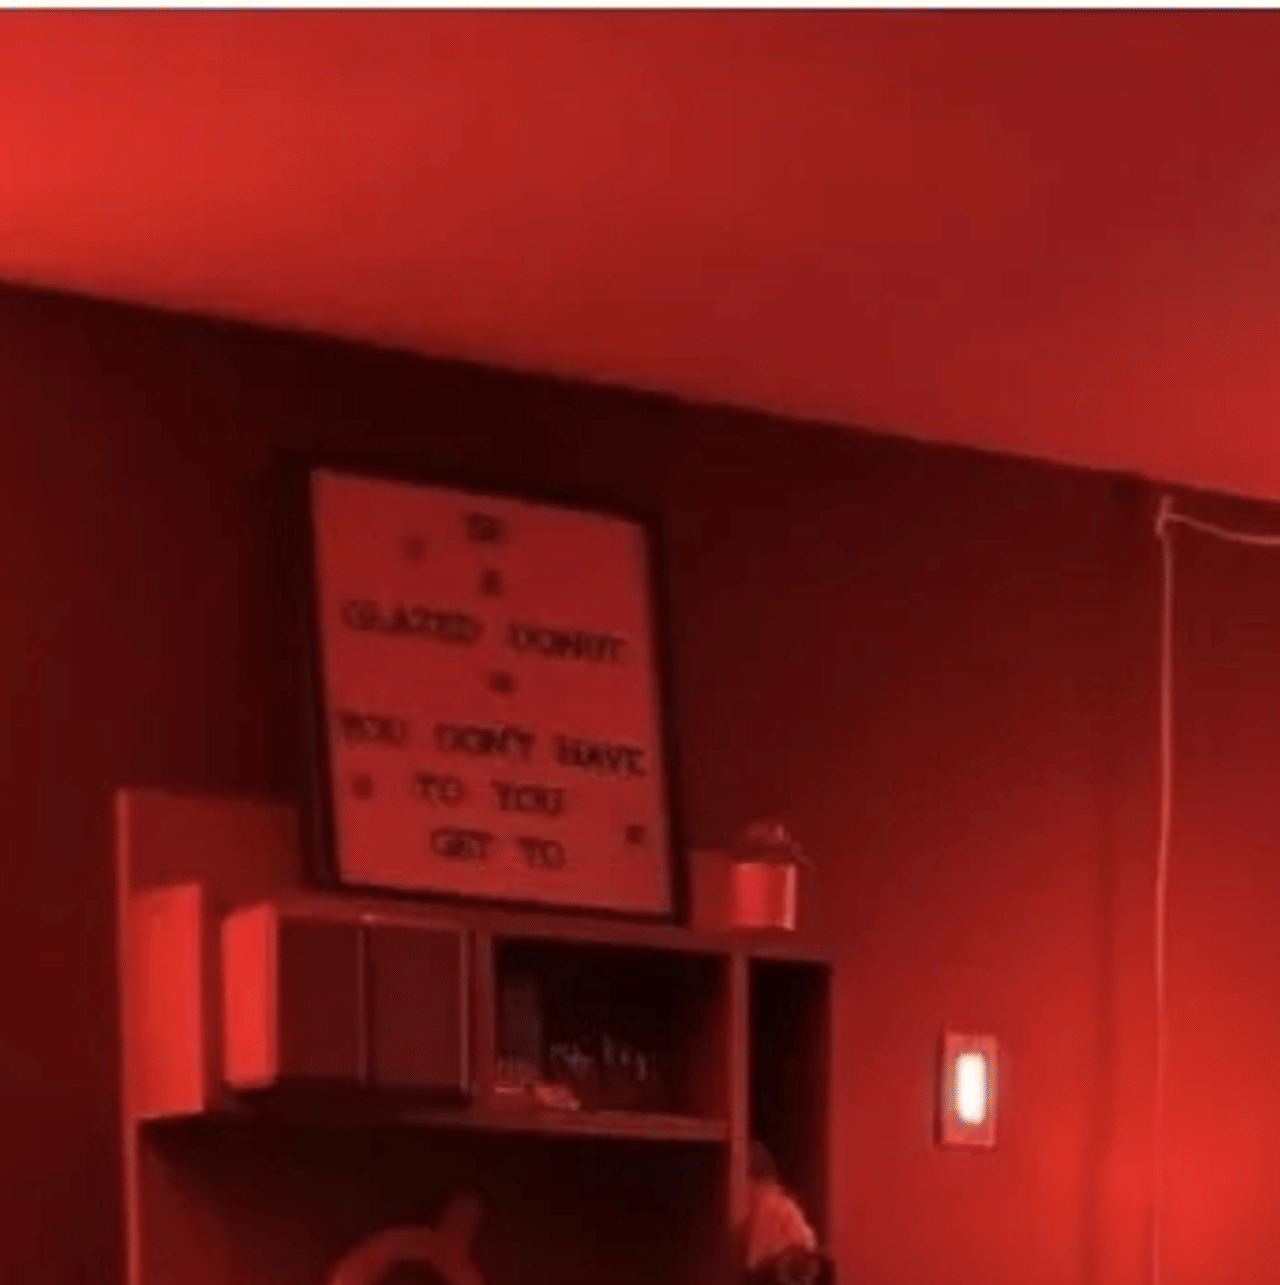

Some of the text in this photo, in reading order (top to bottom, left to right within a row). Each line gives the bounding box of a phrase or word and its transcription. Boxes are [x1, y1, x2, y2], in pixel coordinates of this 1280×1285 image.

[340, 599, 627, 664] GLAZED DONUT
[338, 709, 408, 747] YOU
[554, 735, 646, 778] HAVE
[415, 771, 465, 807] TO
[516, 836, 566, 871] TO
